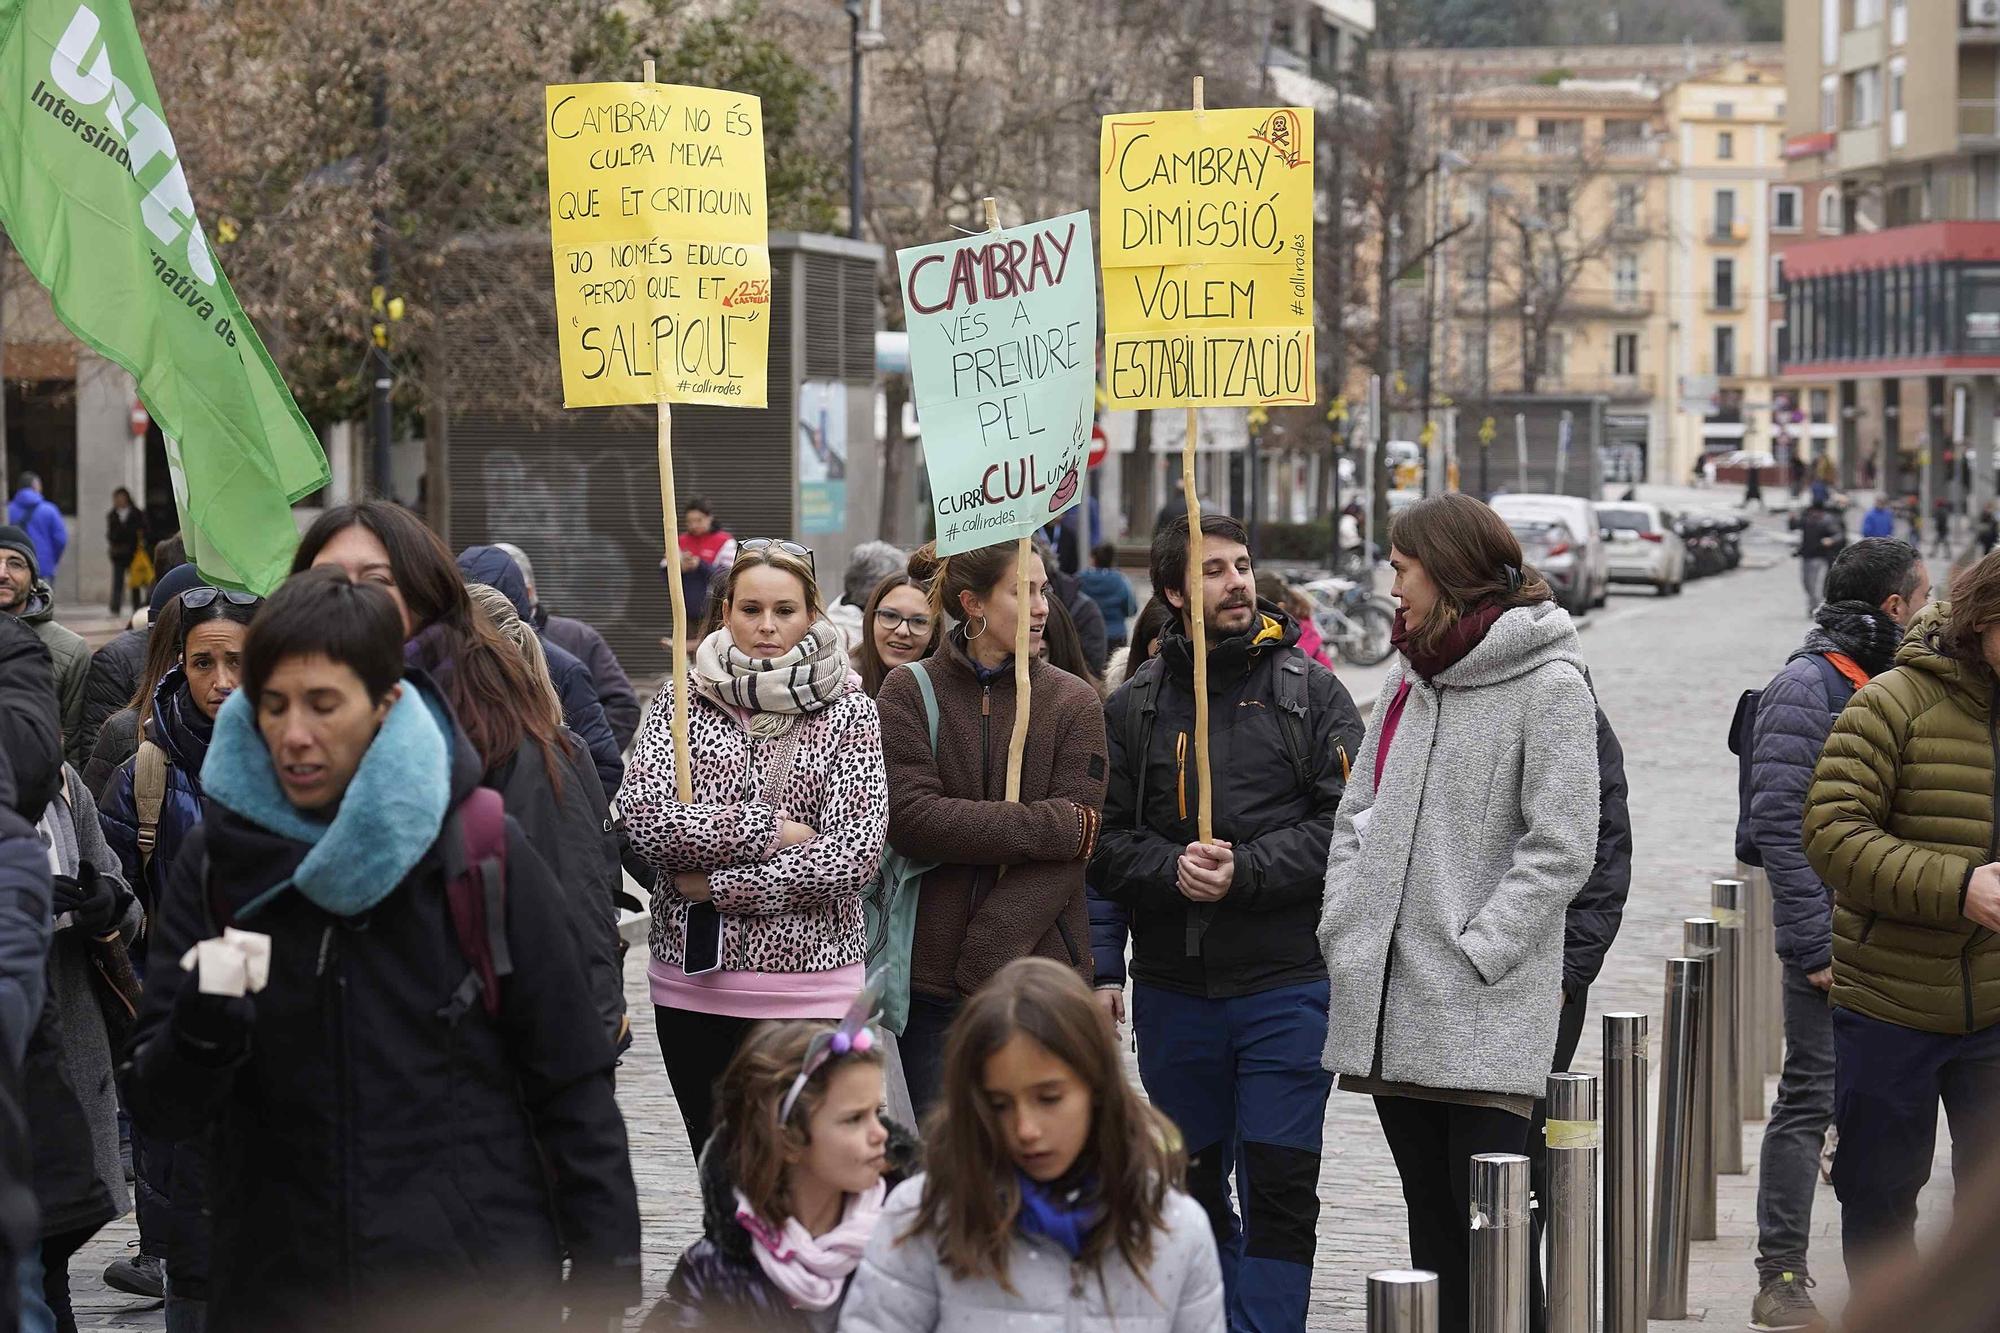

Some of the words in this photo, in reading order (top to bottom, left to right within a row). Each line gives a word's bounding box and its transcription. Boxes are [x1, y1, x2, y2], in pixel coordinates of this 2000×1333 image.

[551, 96, 672, 140] CAMBRAY
[685, 107, 711, 132] NO
[726, 103, 752, 136] ÉS
[589, 142, 655, 170] CULPA
[669, 142, 724, 167] MEVA
[1119, 134, 1270, 192] CAMBRAY
[558, 189, 600, 220] QUE
[621, 186, 644, 217] ET
[567, 251, 593, 274] JO
[611, 236, 672, 268] NOMÉS
[687, 244, 748, 267] EDUCO
[907, 222, 1076, 315] CAMBRAY
[578, 275, 636, 306] PERDÓ
[647, 275, 681, 299] QUE
[699, 277, 726, 300] ET
[738, 279, 769, 297] 25%
[1134, 265, 1254, 320] VOLEM
[939, 307, 989, 346] VÉS
[1011, 300, 1031, 329] A
[953, 321, 1080, 397] PRENDRE
[977, 393, 1046, 447] PEL
